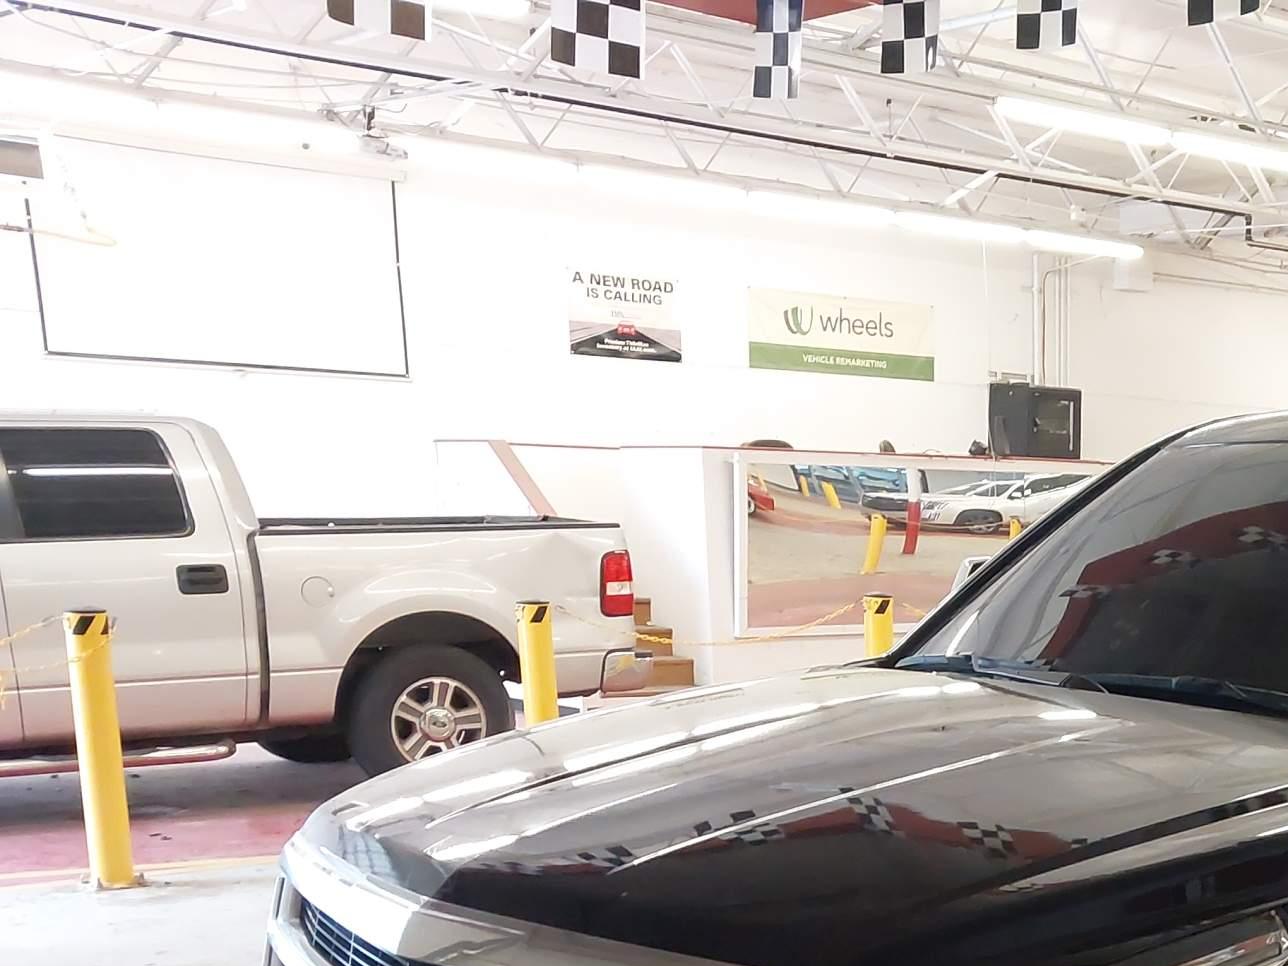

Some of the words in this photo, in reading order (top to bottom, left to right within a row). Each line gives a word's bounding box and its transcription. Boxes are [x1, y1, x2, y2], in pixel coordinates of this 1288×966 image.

[572, 271, 585, 284] A
[590, 273, 626, 289] NEW
[631, 278, 674, 294] ROAD
[586, 287, 600, 299] IS
[603, 289, 663, 306] CALLING
[819, 307, 894, 338] wheels
[802, 353, 835, 365] VEHICLE
[835, 356, 888, 369] REMARKETING
